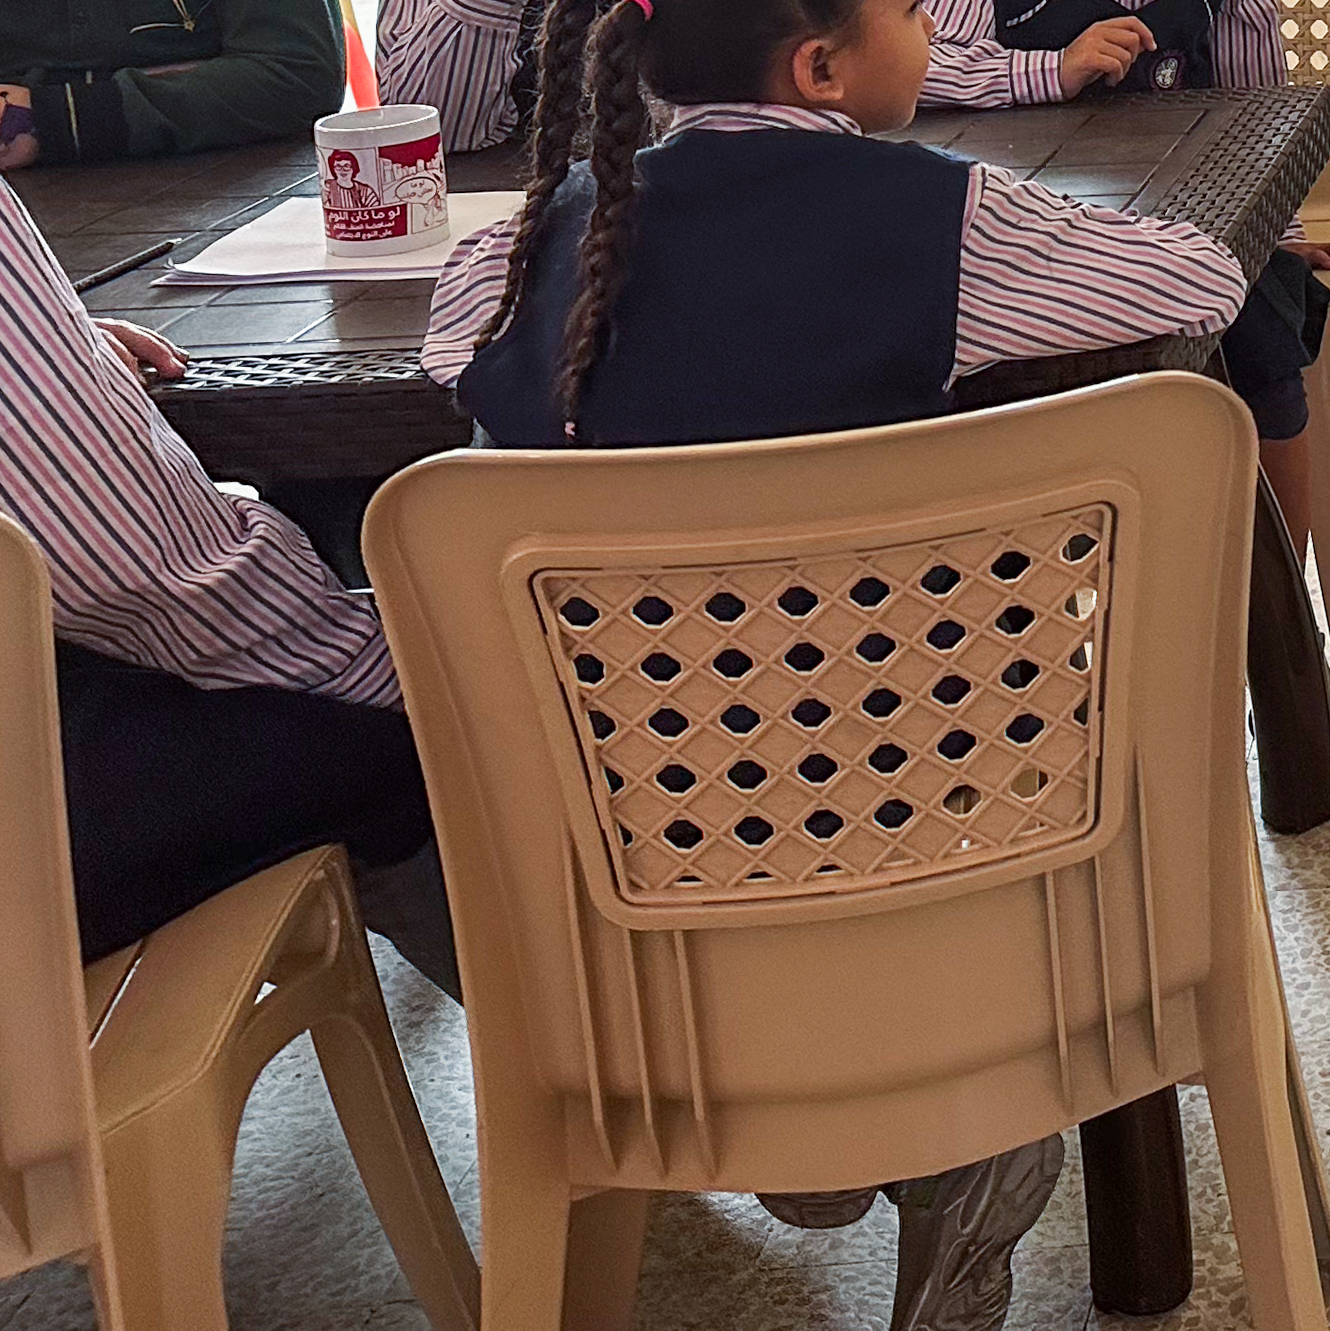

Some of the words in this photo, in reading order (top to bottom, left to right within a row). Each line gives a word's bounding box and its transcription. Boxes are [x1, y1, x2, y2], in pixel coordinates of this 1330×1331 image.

[351, 210, 370, 223] كان
[371, 210, 386, 219] ما
[388, 206, 401, 220] لو
